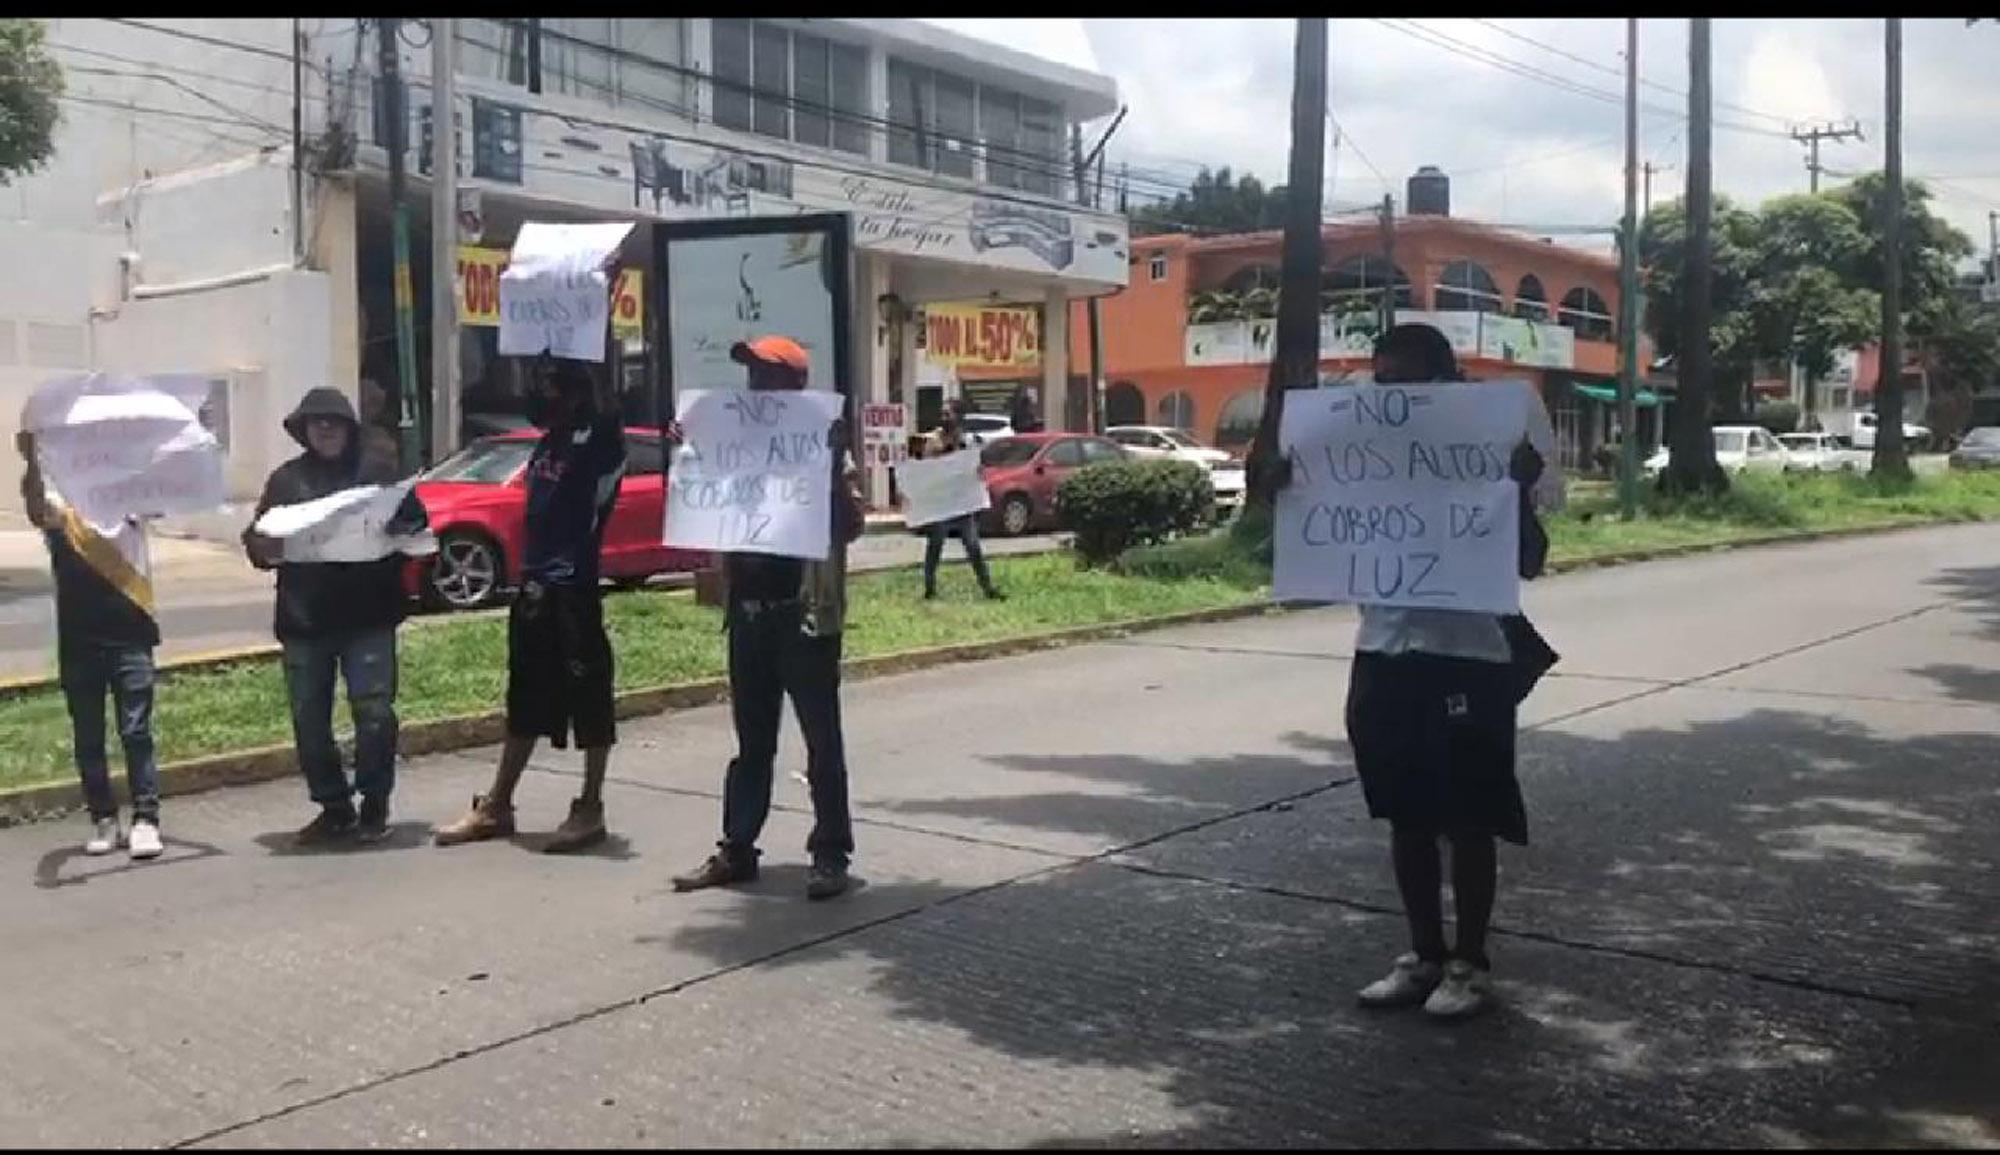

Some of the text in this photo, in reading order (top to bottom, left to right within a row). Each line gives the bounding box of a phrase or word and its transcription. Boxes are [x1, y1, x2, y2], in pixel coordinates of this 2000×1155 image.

[1325, 440, 1394, 484] LOS
[1408, 440, 1504, 482] ALTOS
[1303, 503, 1491, 547] COBROS DE
[1348, 553, 1456, 599] LUZ
